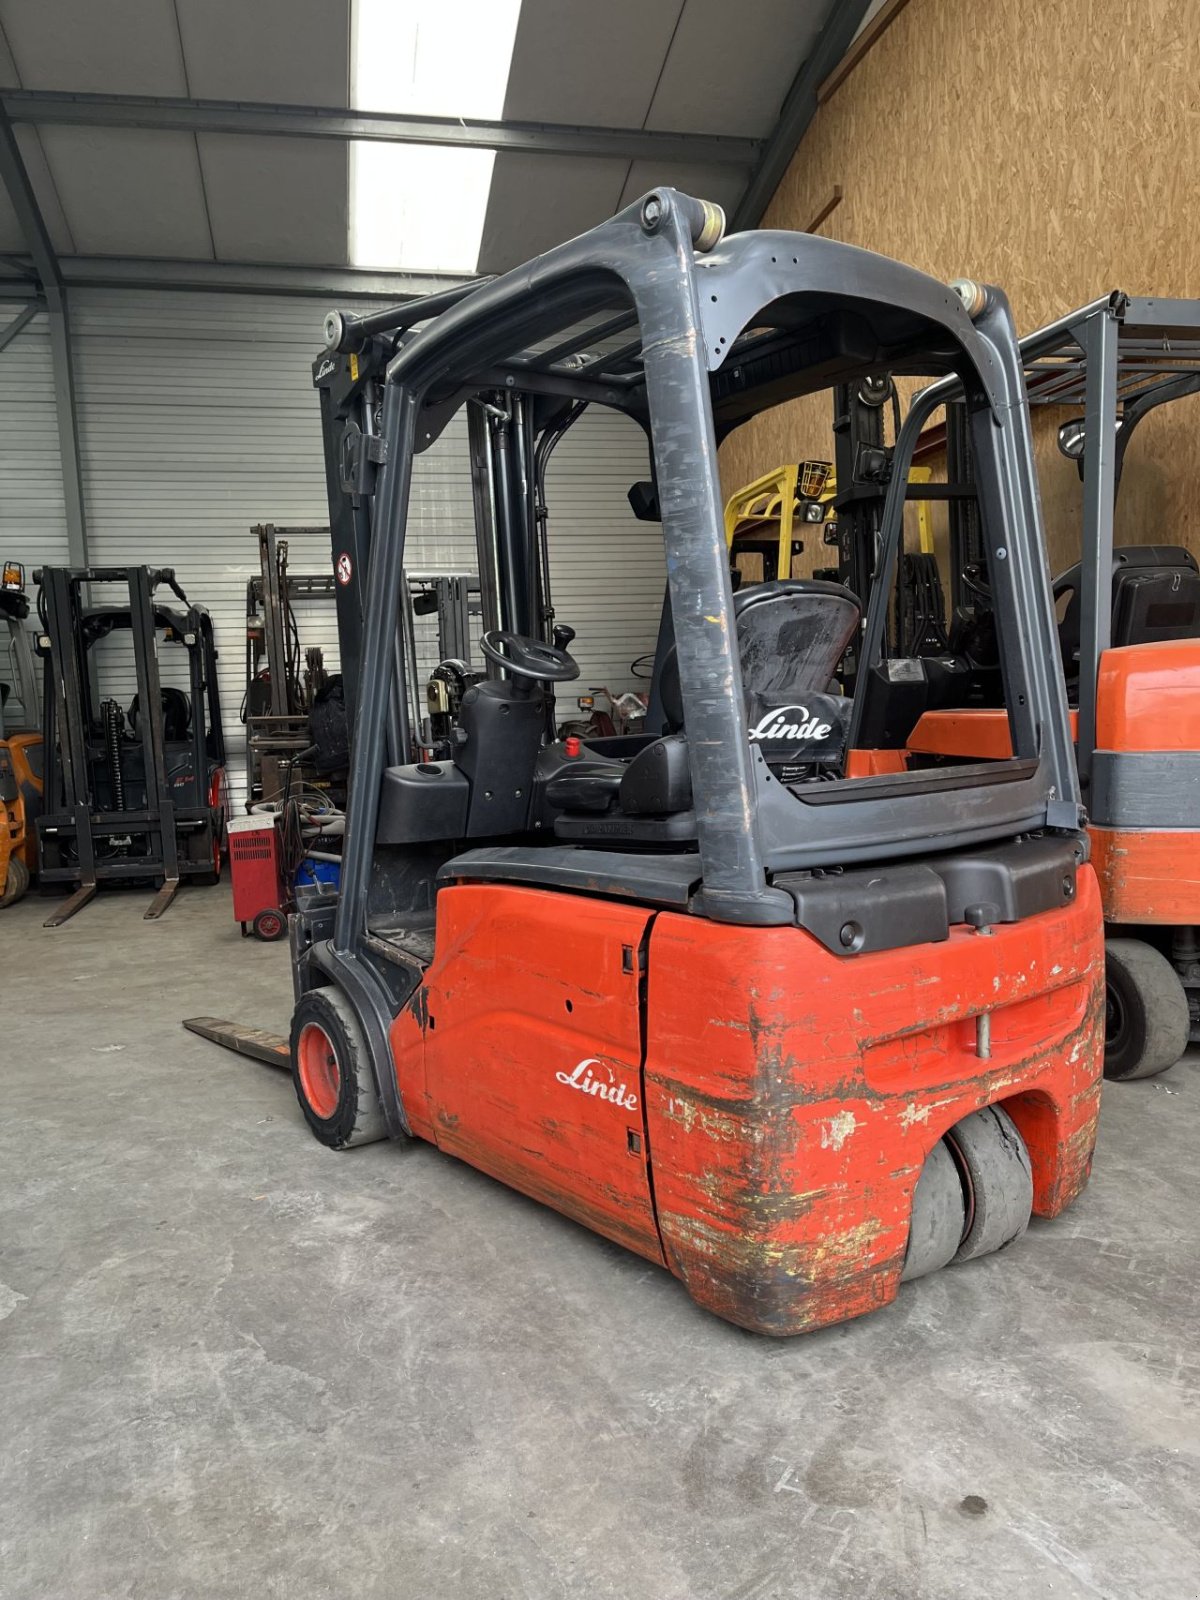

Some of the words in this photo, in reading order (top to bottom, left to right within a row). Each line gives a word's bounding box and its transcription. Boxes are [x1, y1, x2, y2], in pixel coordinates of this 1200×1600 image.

[315, 359, 336, 381] Linde
[748, 705, 832, 740] Linde
[555, 1058, 638, 1111] Linde
